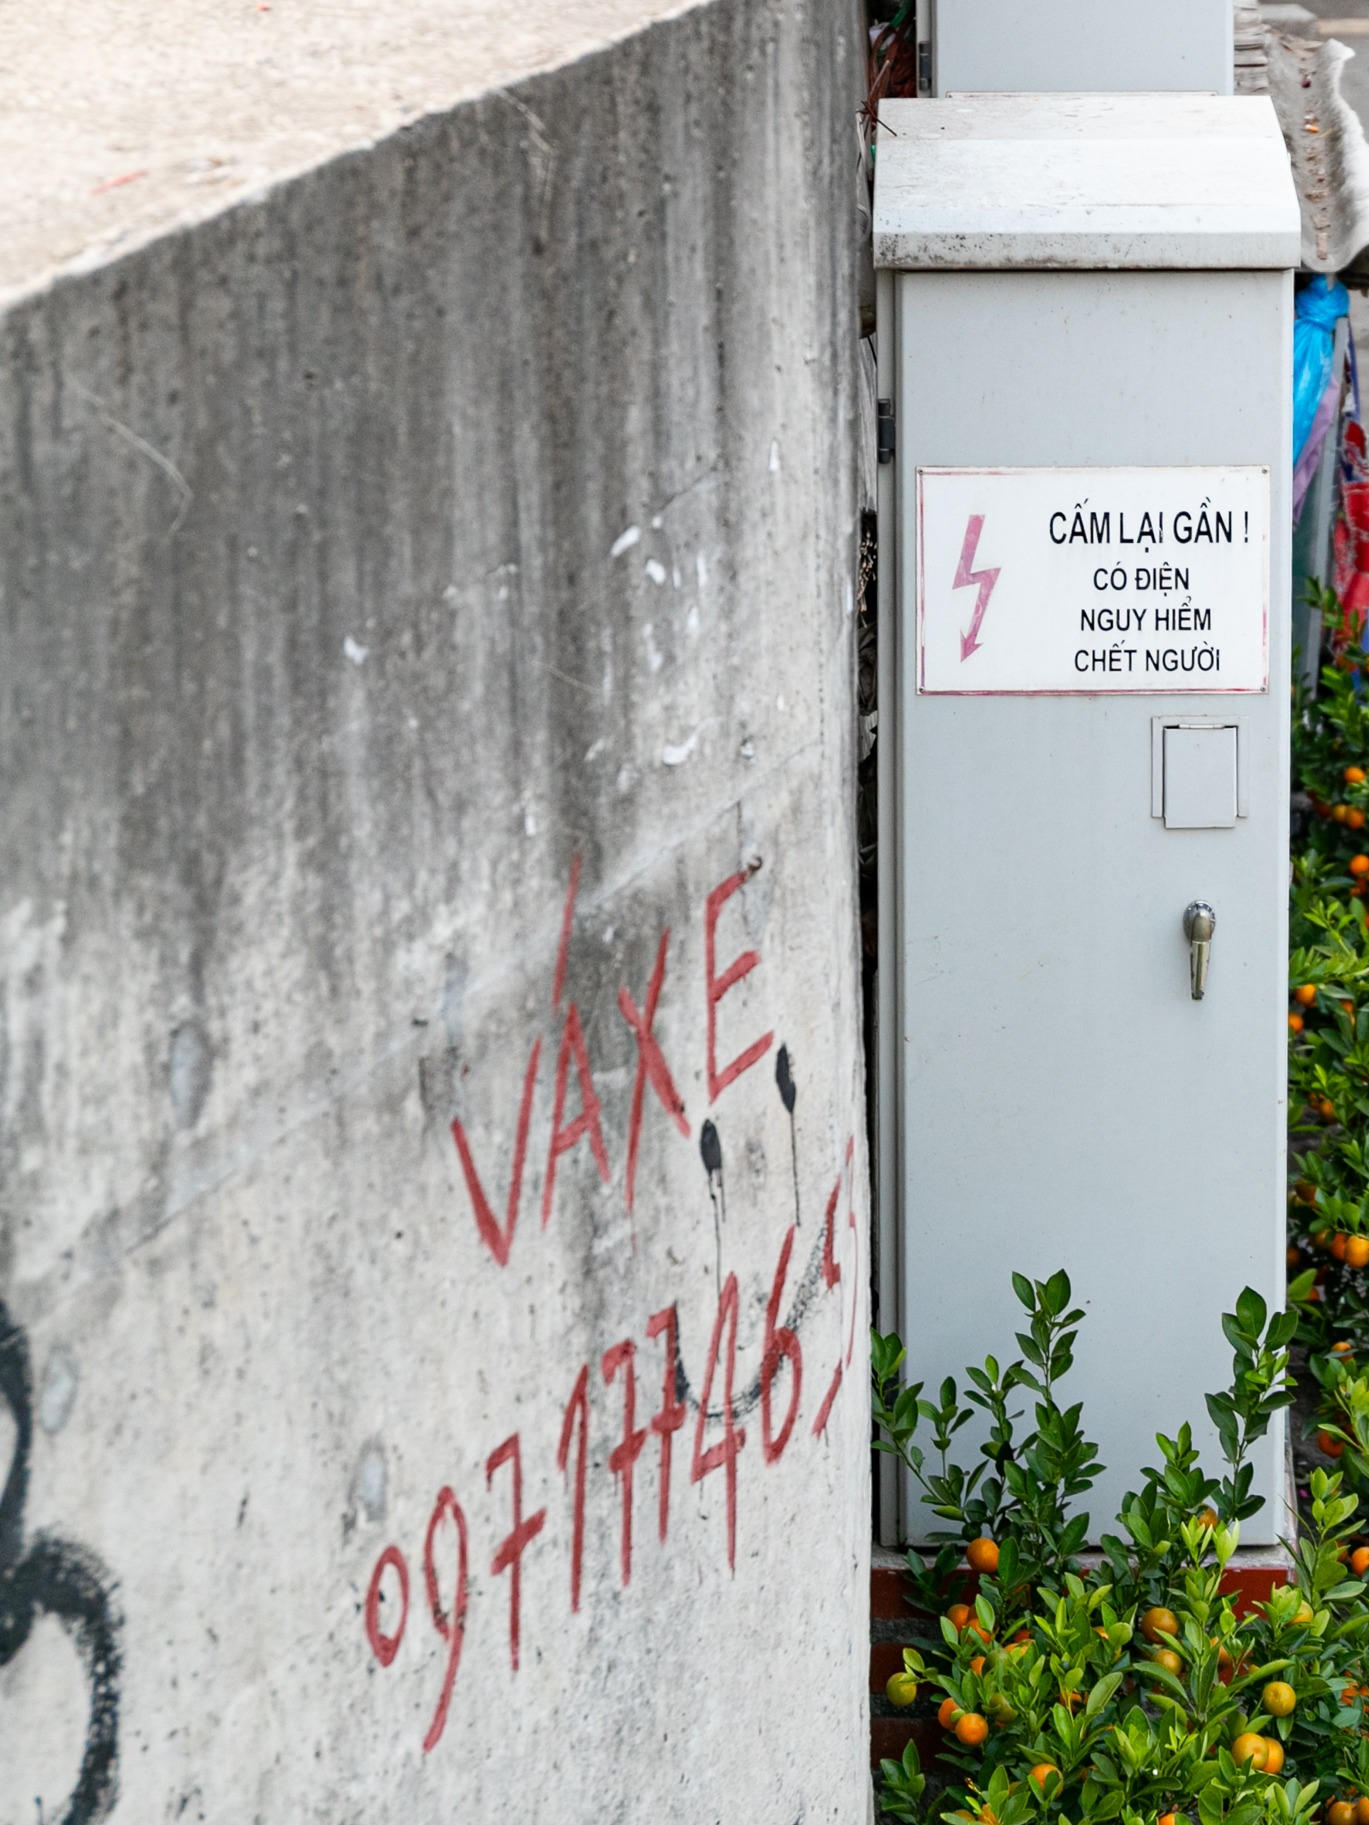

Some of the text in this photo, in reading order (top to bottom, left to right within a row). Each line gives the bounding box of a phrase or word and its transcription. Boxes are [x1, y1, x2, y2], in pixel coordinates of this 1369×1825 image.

[1049, 497, 1111, 544] CẤM
[1119, 511, 1163, 553] LẠI
[1173, 496, 1232, 544] GẦN
[1093, 561, 1189, 597] CÓ ĐIỆN
[1080, 596, 1211, 631] NGUY HIỂM
[1074, 639, 1220, 672] CHẾT NGƯỜI
